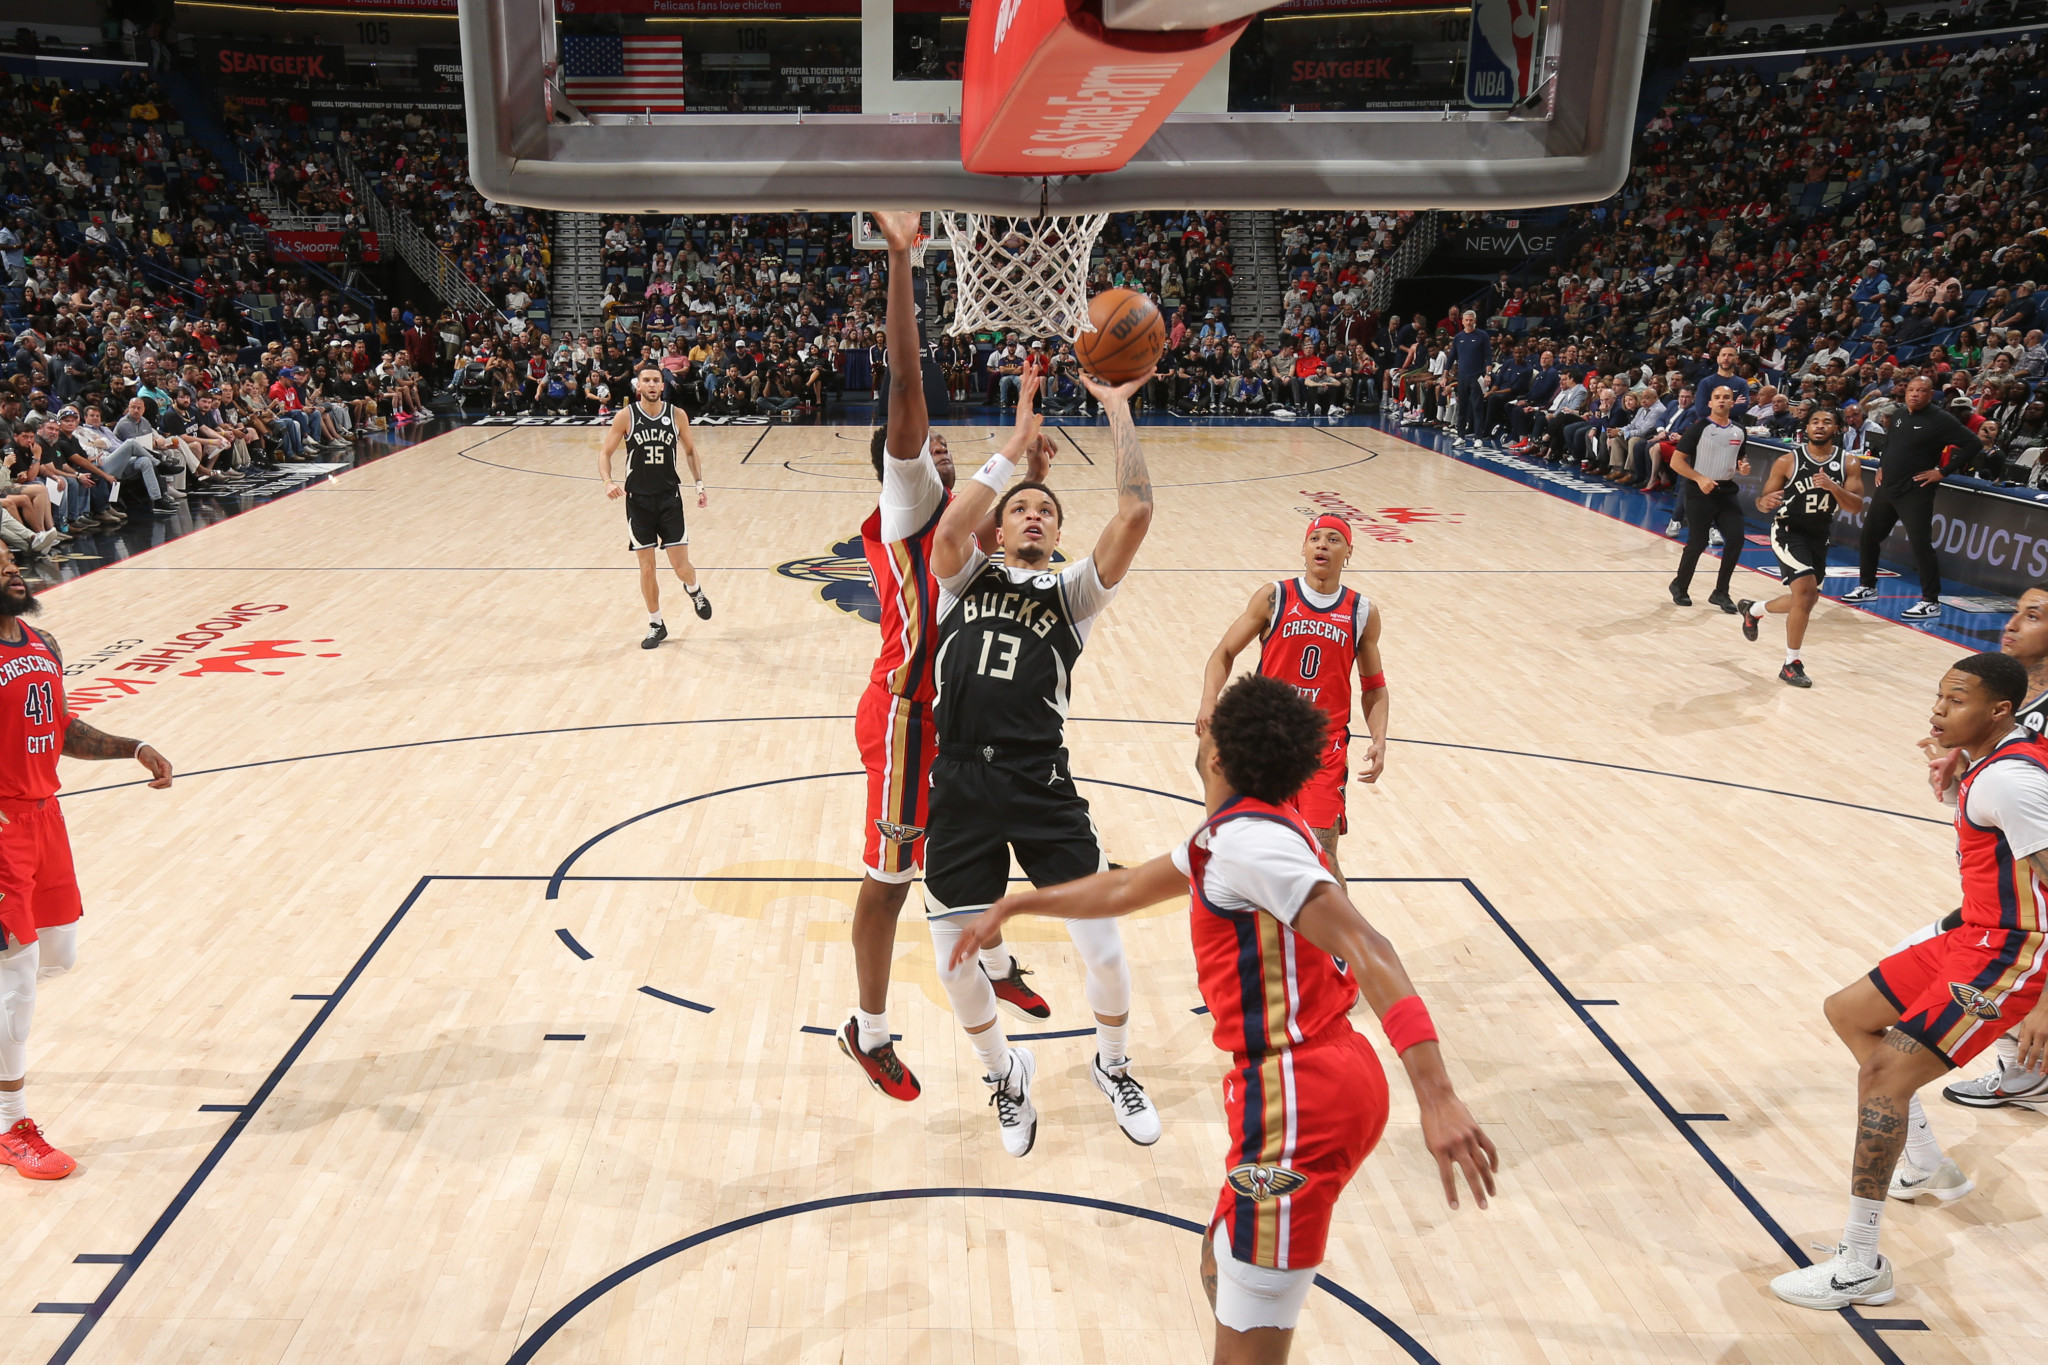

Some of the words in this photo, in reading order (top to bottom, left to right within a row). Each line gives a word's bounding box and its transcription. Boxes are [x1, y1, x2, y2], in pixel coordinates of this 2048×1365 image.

[653, 1, 694, 11] Pelicans
[697, 1, 717, 11] fans
[720, 1, 739, 10] love
[742, 1, 781, 10] chicken
[356, 21, 390, 45] 105
[736, 27, 767, 50] 106
[218, 50, 327, 79] SEATGEEK
[780, 67, 809, 75] OFFICIAL
[809, 67, 844, 75] TICKETING
[1291, 57, 1393, 82] SEATGEEK
[1474, 71, 1505, 97] NBA
[633, 428, 674, 446] BUCKS
[643, 445, 665, 465] 35
[1805, 493, 1830, 514] 24
[964, 592, 1059, 639] BUCKS
[1282, 619, 1349, 648] CRESCENT
[977, 630, 1022, 681] 13
[1300, 644, 1322, 680] 0
[24, 681, 54, 726] 41
[27, 730, 56, 755] CITY
